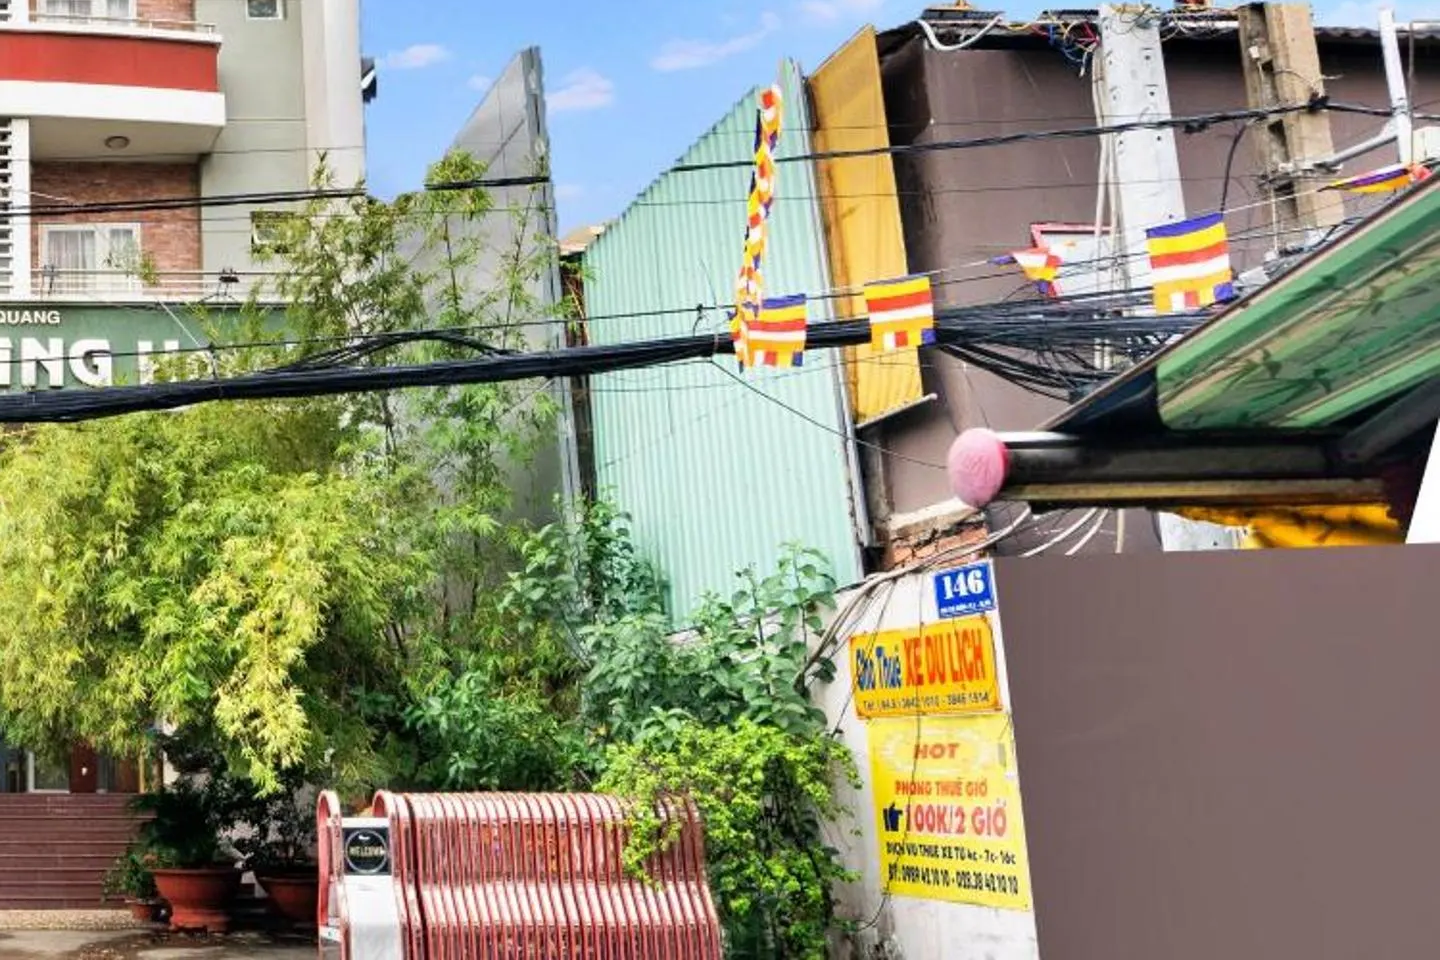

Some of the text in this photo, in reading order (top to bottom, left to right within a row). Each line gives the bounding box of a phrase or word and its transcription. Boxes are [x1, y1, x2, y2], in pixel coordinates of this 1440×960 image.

[942, 569, 986, 601] 146
[904, 637, 924, 686] XE
[925, 633, 947, 685] DU
[913, 742, 960, 760] HOT
